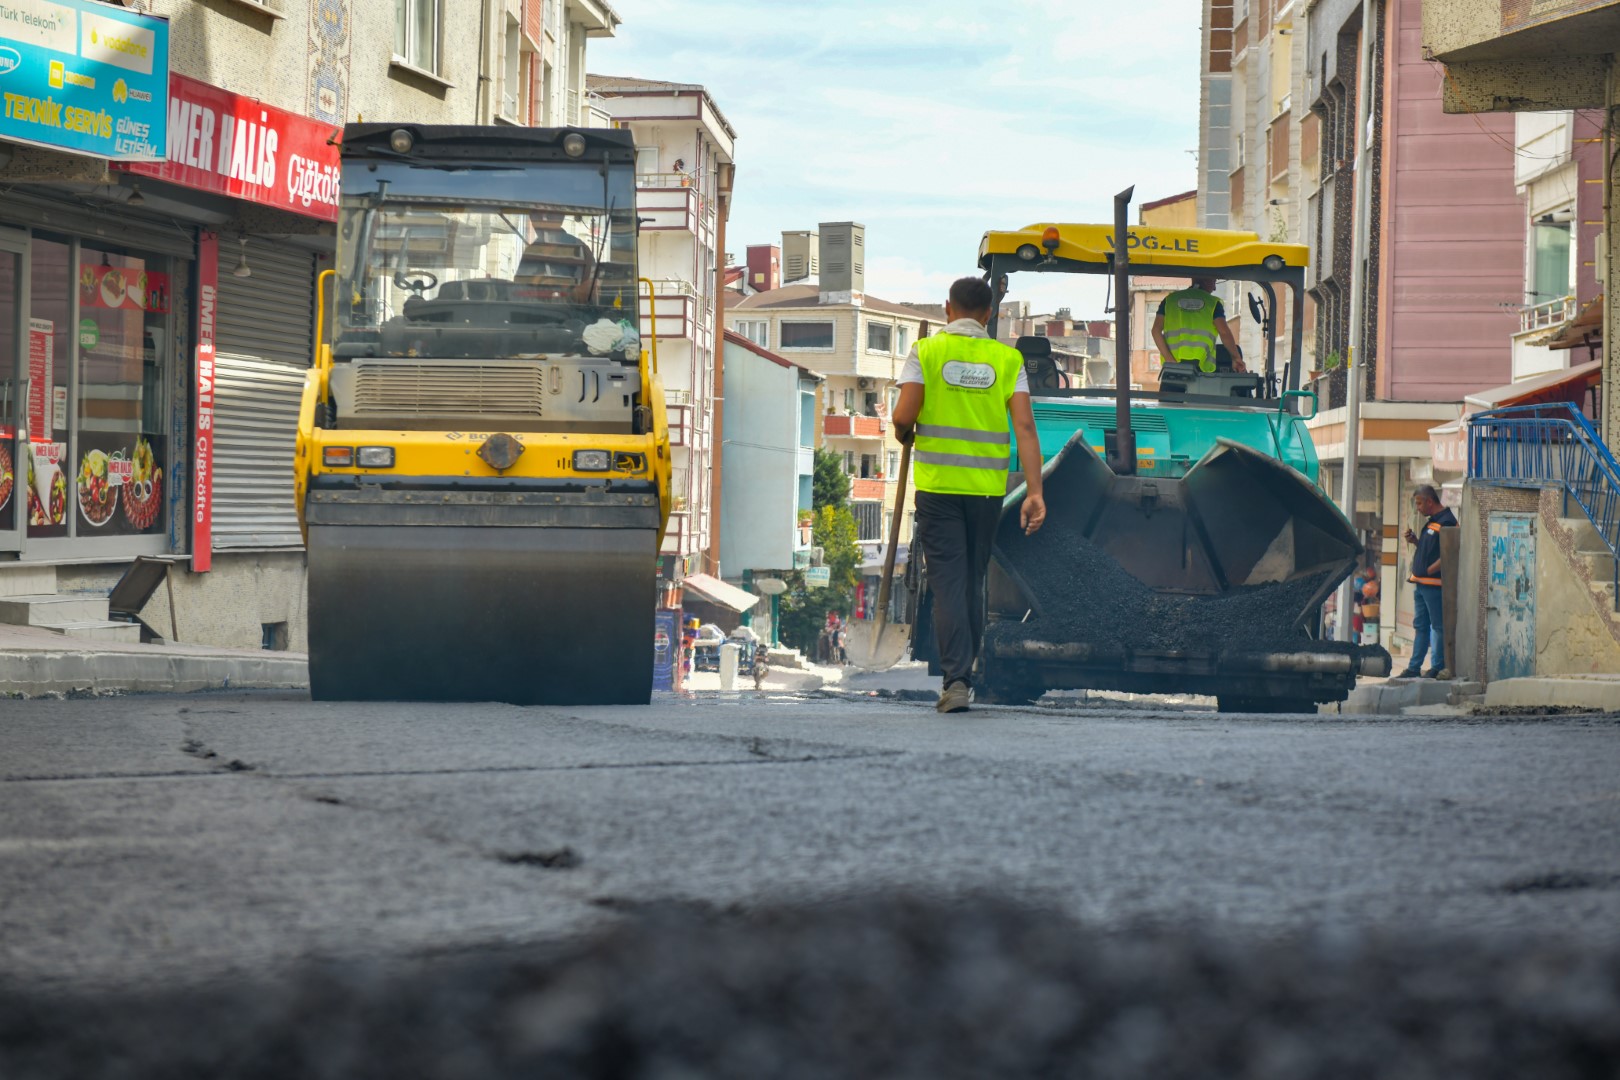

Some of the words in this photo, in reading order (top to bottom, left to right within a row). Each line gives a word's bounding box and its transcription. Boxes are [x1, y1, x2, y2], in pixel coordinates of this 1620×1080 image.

[0, 5, 18, 21] Türk
[20, 11, 56, 31] Telekom
[103, 34, 148, 59] vodafone
[4, 92, 62, 128] TEKNİK
[64, 109, 112, 139] SERVİS
[129, 89, 151, 102] HUAWEI
[217, 111, 278, 188] HALİS
[199, 360, 213, 430] HALİS
[196, 436, 207, 522] Çiğköfte
